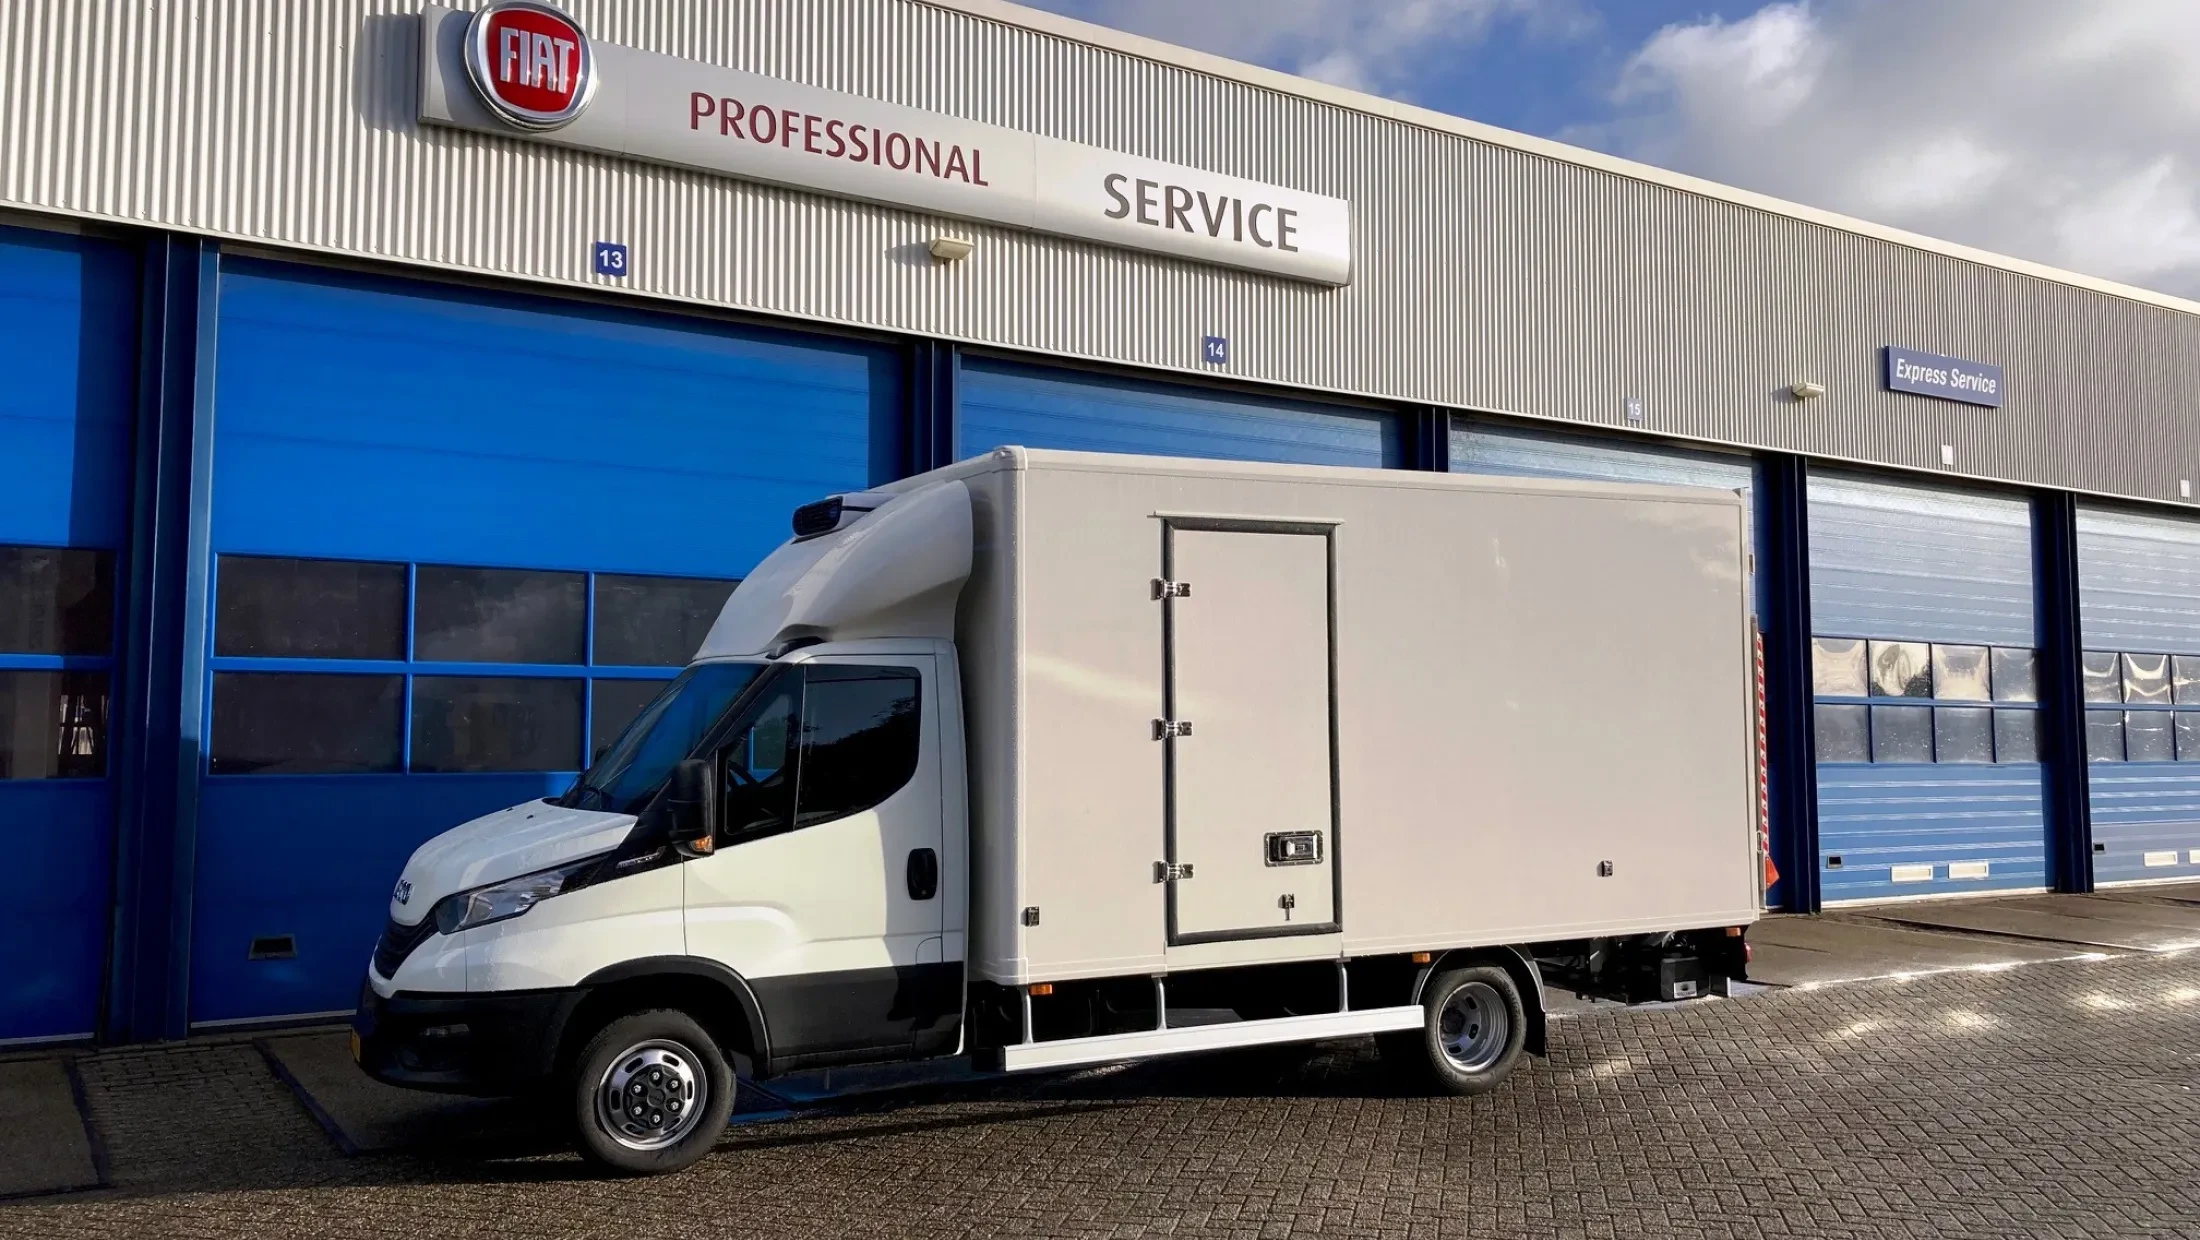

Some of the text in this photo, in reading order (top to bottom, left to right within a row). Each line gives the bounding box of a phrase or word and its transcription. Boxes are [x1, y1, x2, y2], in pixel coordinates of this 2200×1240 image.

[500, 26, 575, 95] FIAT
[690, 92, 989, 187] PROFESSIONAL
[1103, 173, 1299, 253] SERVICE
[599, 249, 623, 269] 13
[1208, 342, 1225, 358] 14
[1895, 357, 1997, 394] Express Service
[1628, 402, 1641, 416] 15
